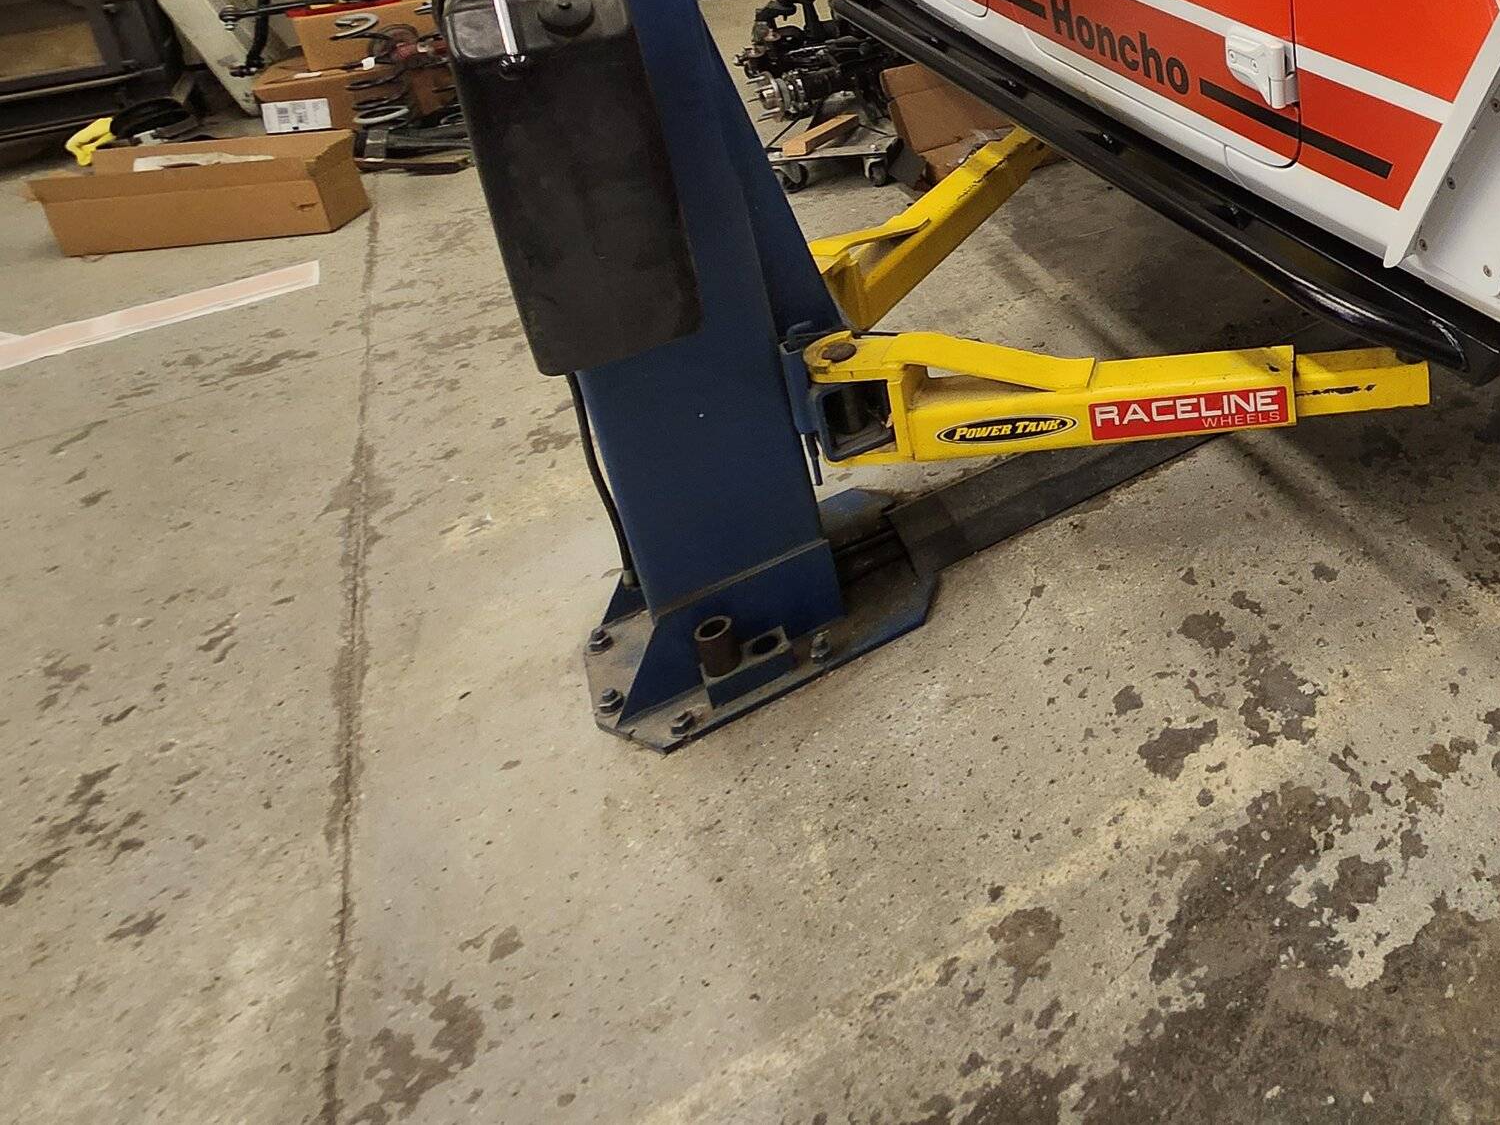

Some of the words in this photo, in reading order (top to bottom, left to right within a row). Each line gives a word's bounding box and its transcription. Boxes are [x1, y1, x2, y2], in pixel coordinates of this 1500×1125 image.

[1094, 390, 1280, 427] RACELINE
[1202, 411, 1281, 428] WHEELS
[953, 423, 1012, 441] POWER
